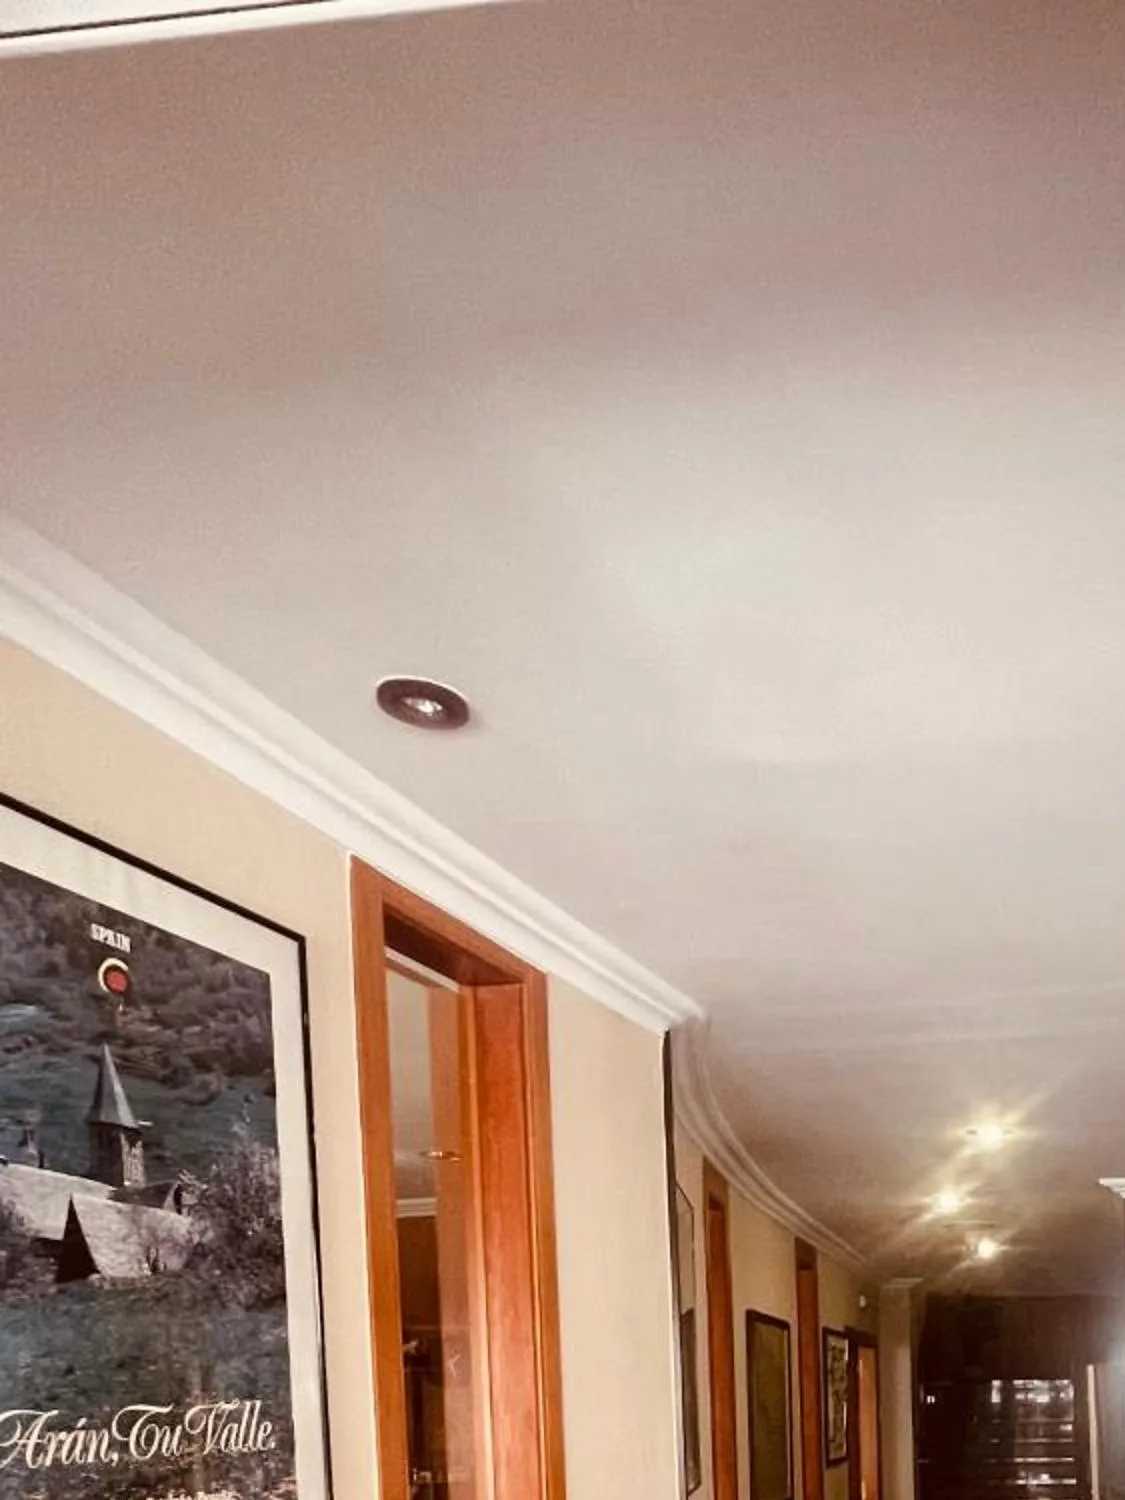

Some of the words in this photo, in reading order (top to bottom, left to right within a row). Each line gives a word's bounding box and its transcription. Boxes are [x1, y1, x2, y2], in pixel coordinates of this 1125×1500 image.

[91, 923, 131, 954] SPAIN
[0, 1409, 119, 1469] Arán,
[112, 1404, 183, 1460] Tu
